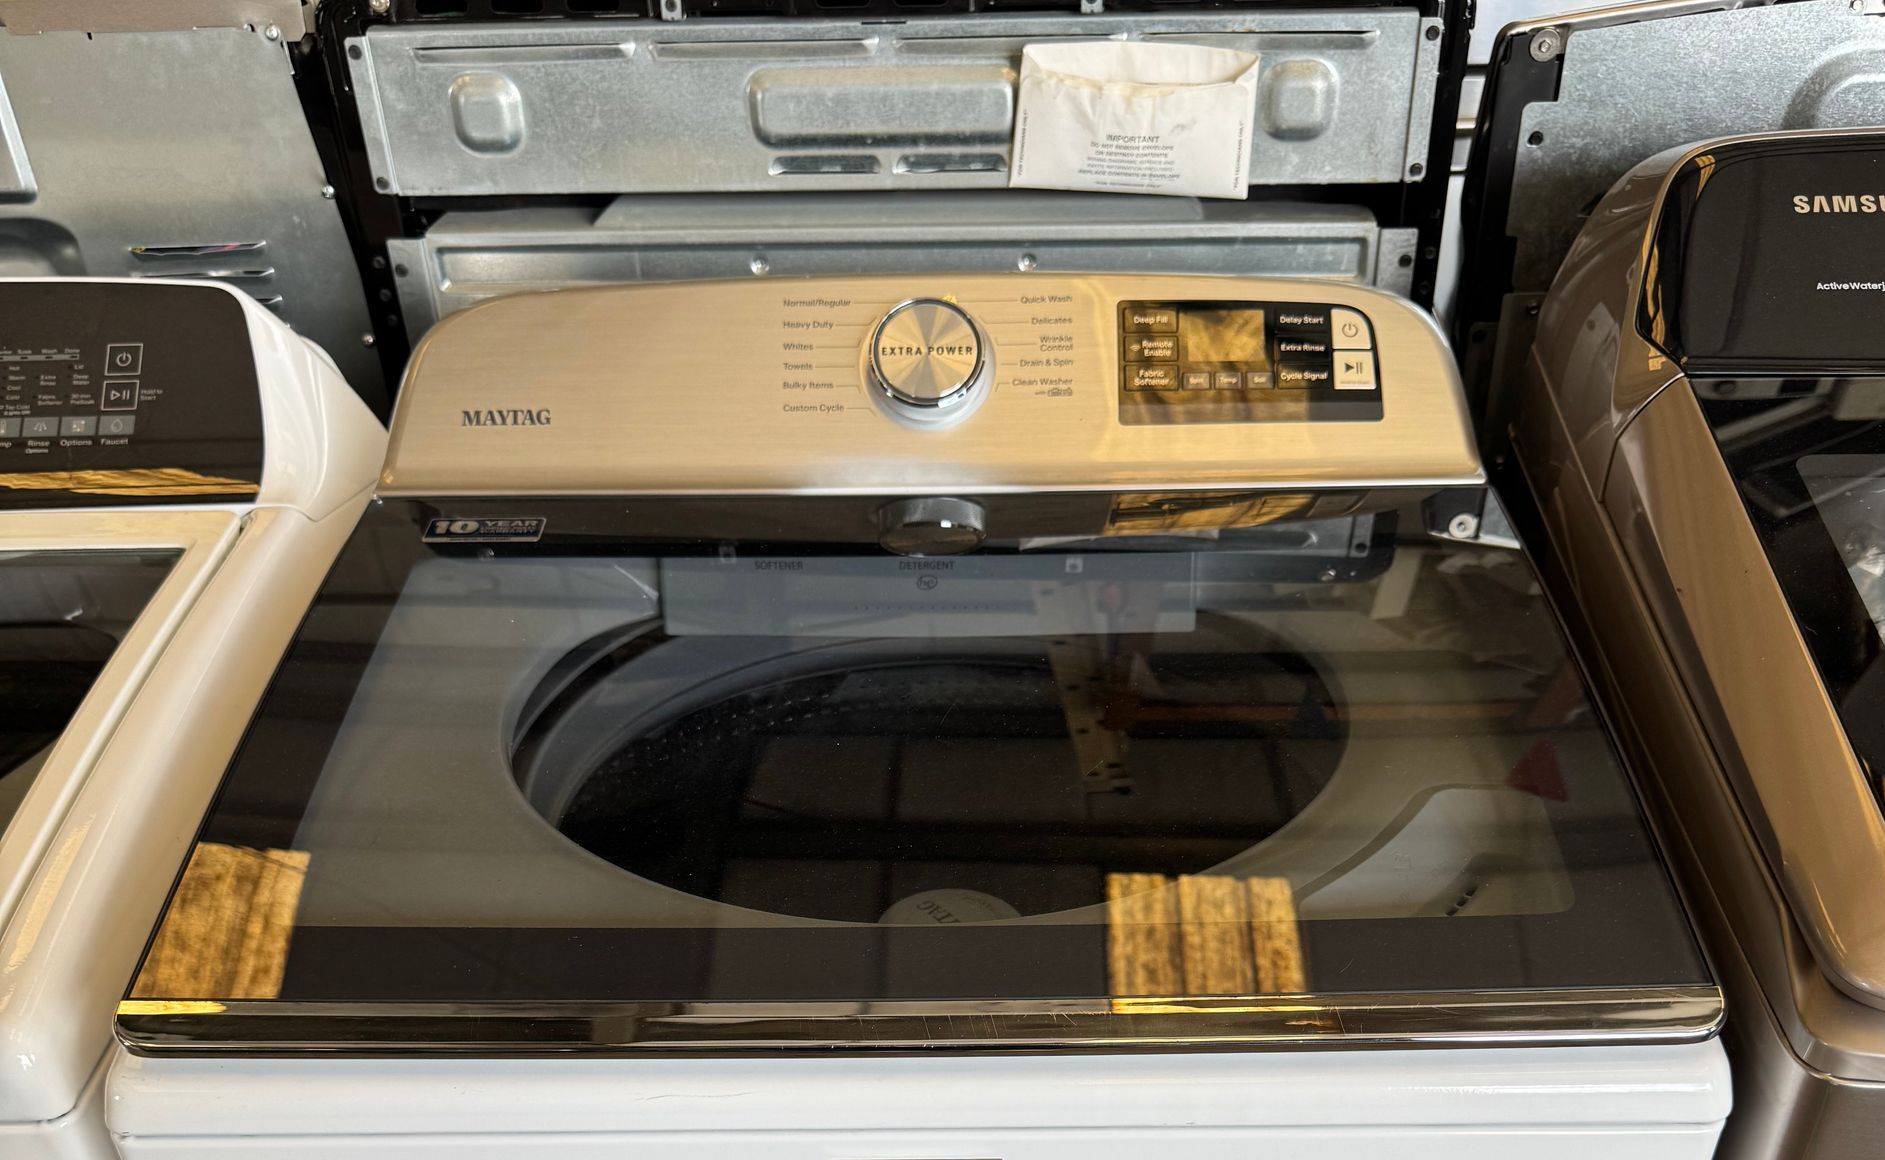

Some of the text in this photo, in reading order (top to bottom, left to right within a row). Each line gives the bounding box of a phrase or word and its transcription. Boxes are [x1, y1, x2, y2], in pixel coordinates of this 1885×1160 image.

[1106, 134, 1160, 144] IMPORTANT
[1020, 295, 1073, 305] Quick Wash
[783, 320, 834, 330] Heavy Duty
[1031, 317, 1073, 325] Delicates
[1134, 316, 1168, 325] Deep Fill
[1279, 315, 1324, 326] Delay Start
[1040, 335, 1073, 344] Wrinkle
[783, 342, 814, 351] Whites
[1040, 344, 1073, 352] Control
[1142, 340, 1173, 349] Remote
[1280, 344, 1325, 353] Extra Rinse
[881, 346, 973, 357] EXTRA POWER
[1144, 349, 1171, 357] Enable
[783, 362, 813, 371] Towels
[1020, 358, 1074, 368] Drain & Spin
[1139, 369, 1164, 378] Fabric
[1280, 371, 1328, 382] Cycle Signal
[783, 381, 834, 391] Bulky Items
[1012, 377, 1073, 387] Clean Washer
[1134, 377, 1169, 386] Softener
[783, 403, 845, 414] Custom Cycle
[461, 409, 551, 427] MAYTAG
[0, 441, 12, 449] mp
[60, 439, 93, 448] Options
[101, 437, 129, 446] Faucet
[434, 520, 538, 534] 10 YEAR
[754, 560, 803, 571] SOFTENER
[899, 560, 954, 571] DETERGENT
